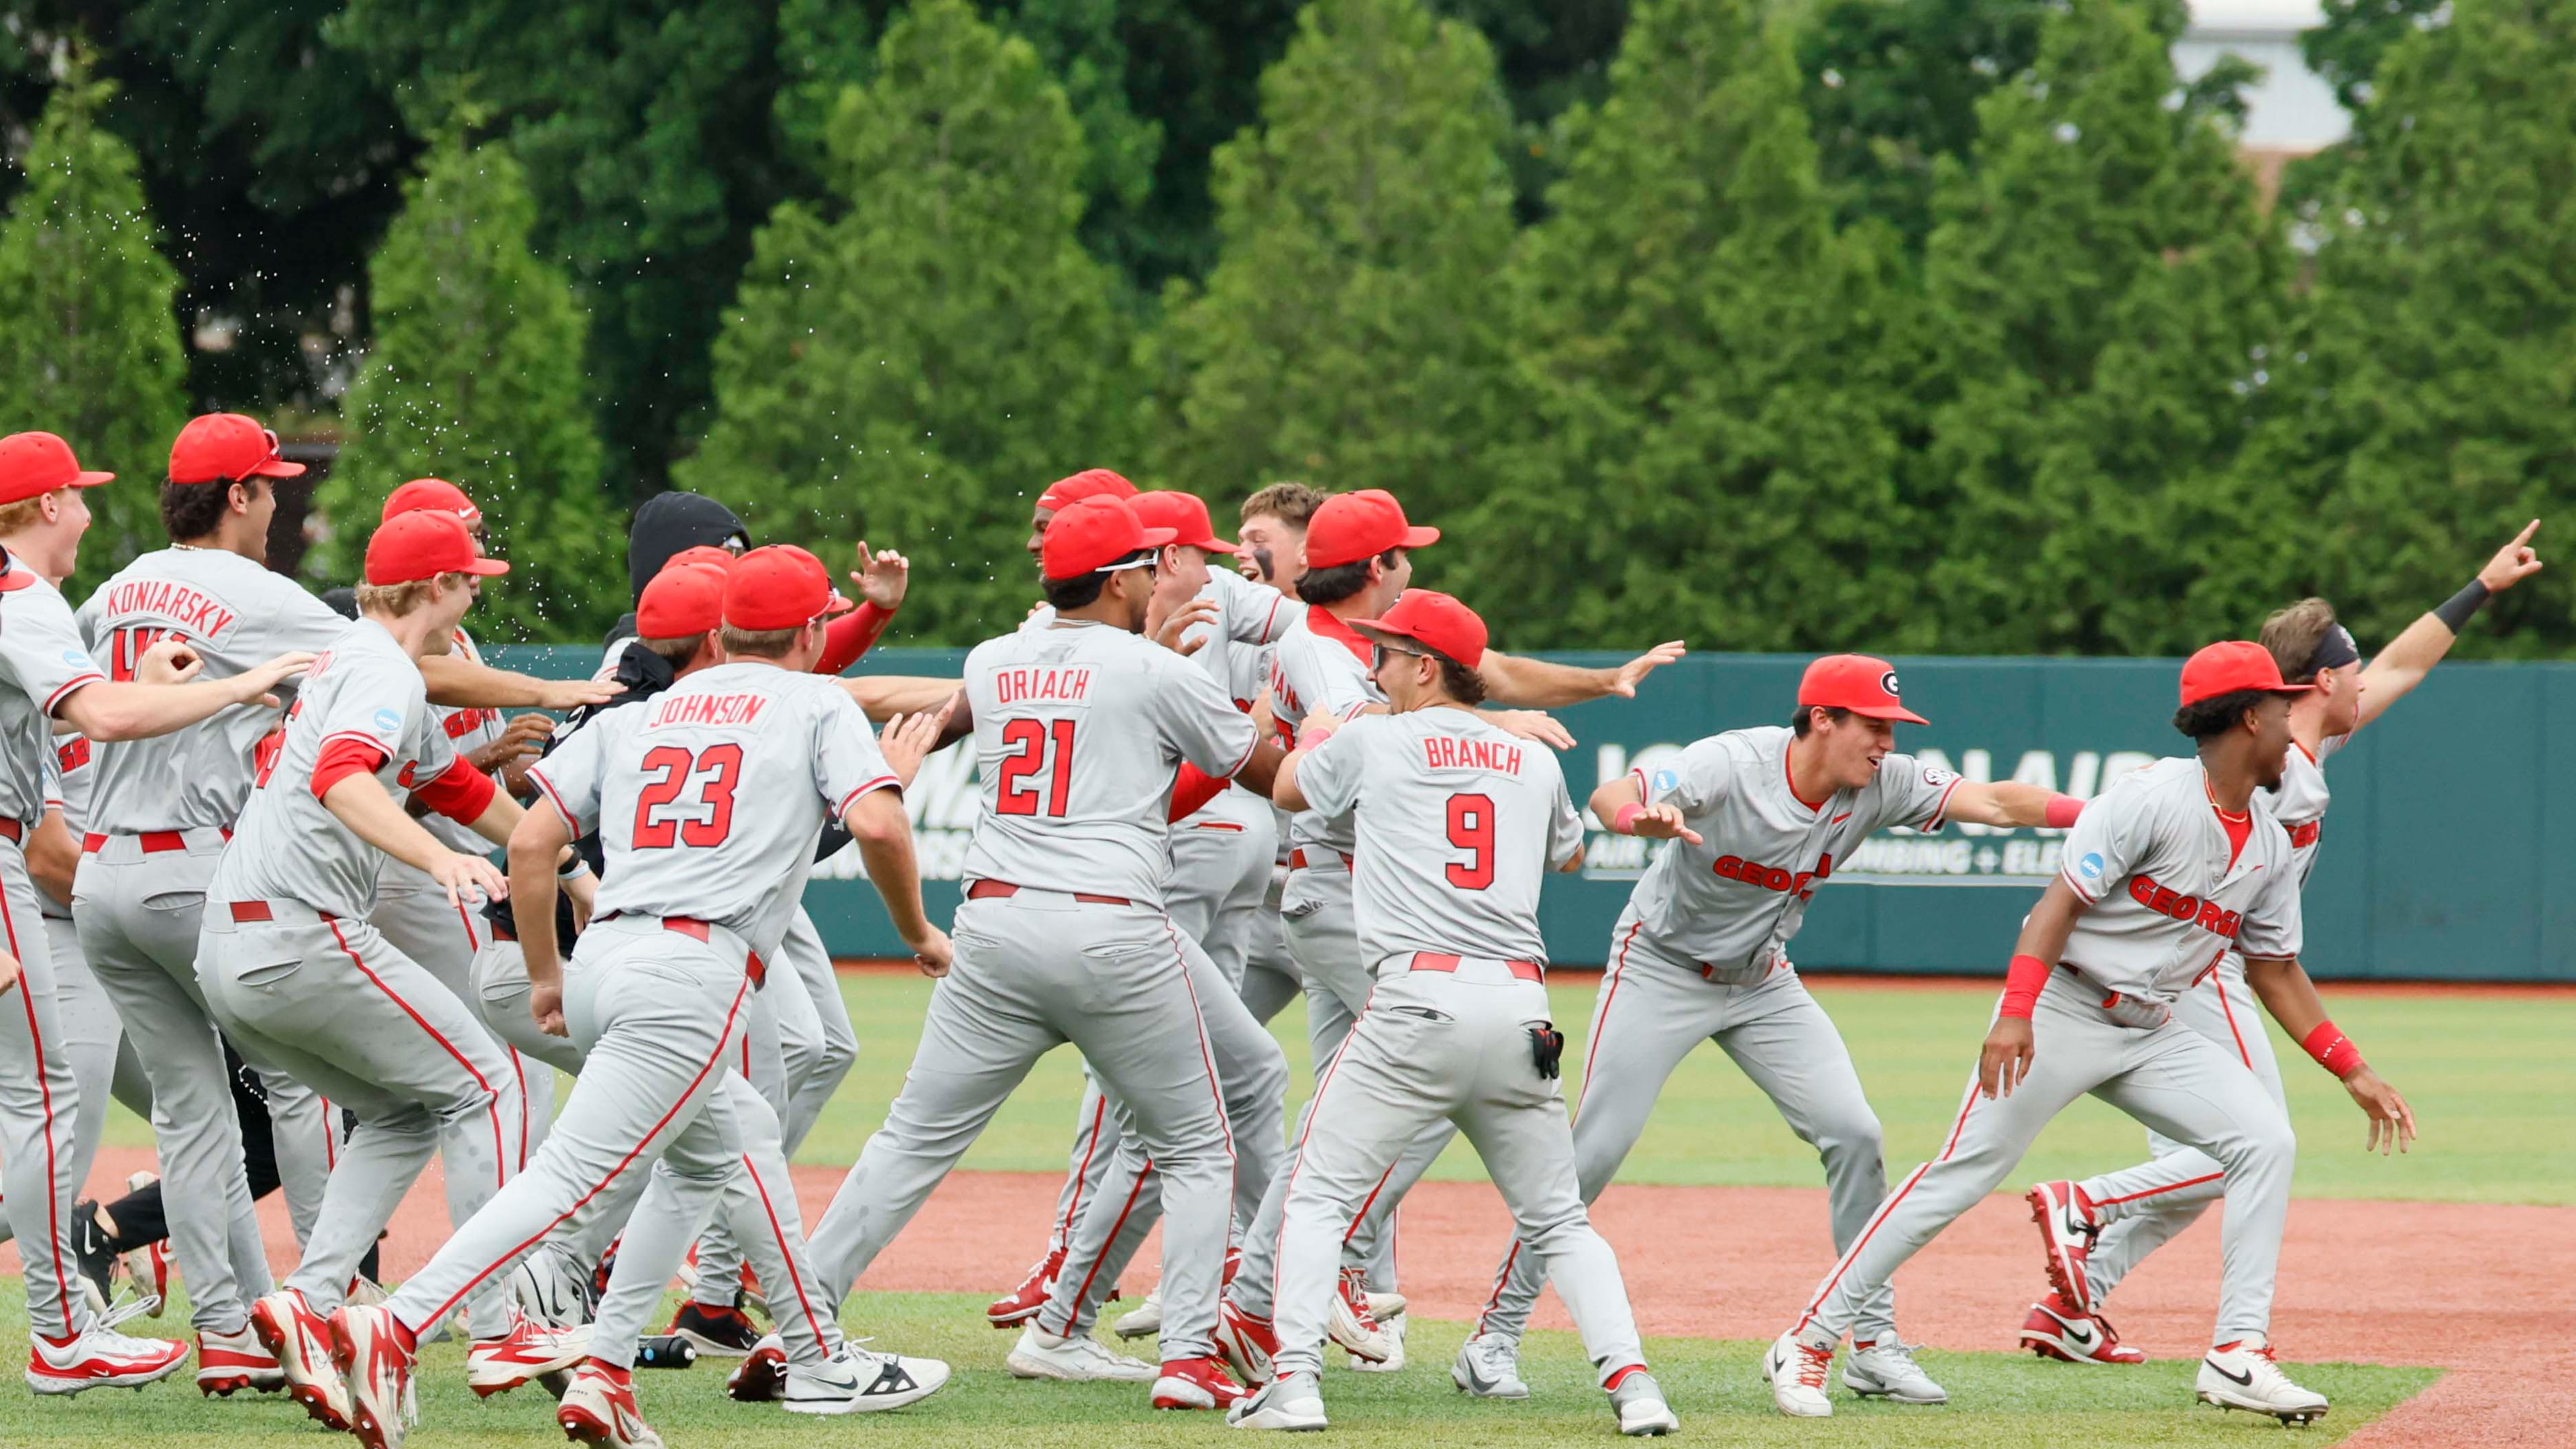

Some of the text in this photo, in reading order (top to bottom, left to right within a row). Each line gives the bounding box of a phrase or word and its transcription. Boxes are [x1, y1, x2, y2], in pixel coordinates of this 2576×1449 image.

[107, 581, 233, 639] KONIARSKY
[649, 694, 767, 729] JOHNSON
[997, 669, 1089, 704] ORIACH
[996, 718, 1076, 818] 21
[1424, 737, 1522, 776] BRANCH
[631, 743, 744, 851] 23
[1445, 792, 1495, 891] 9
